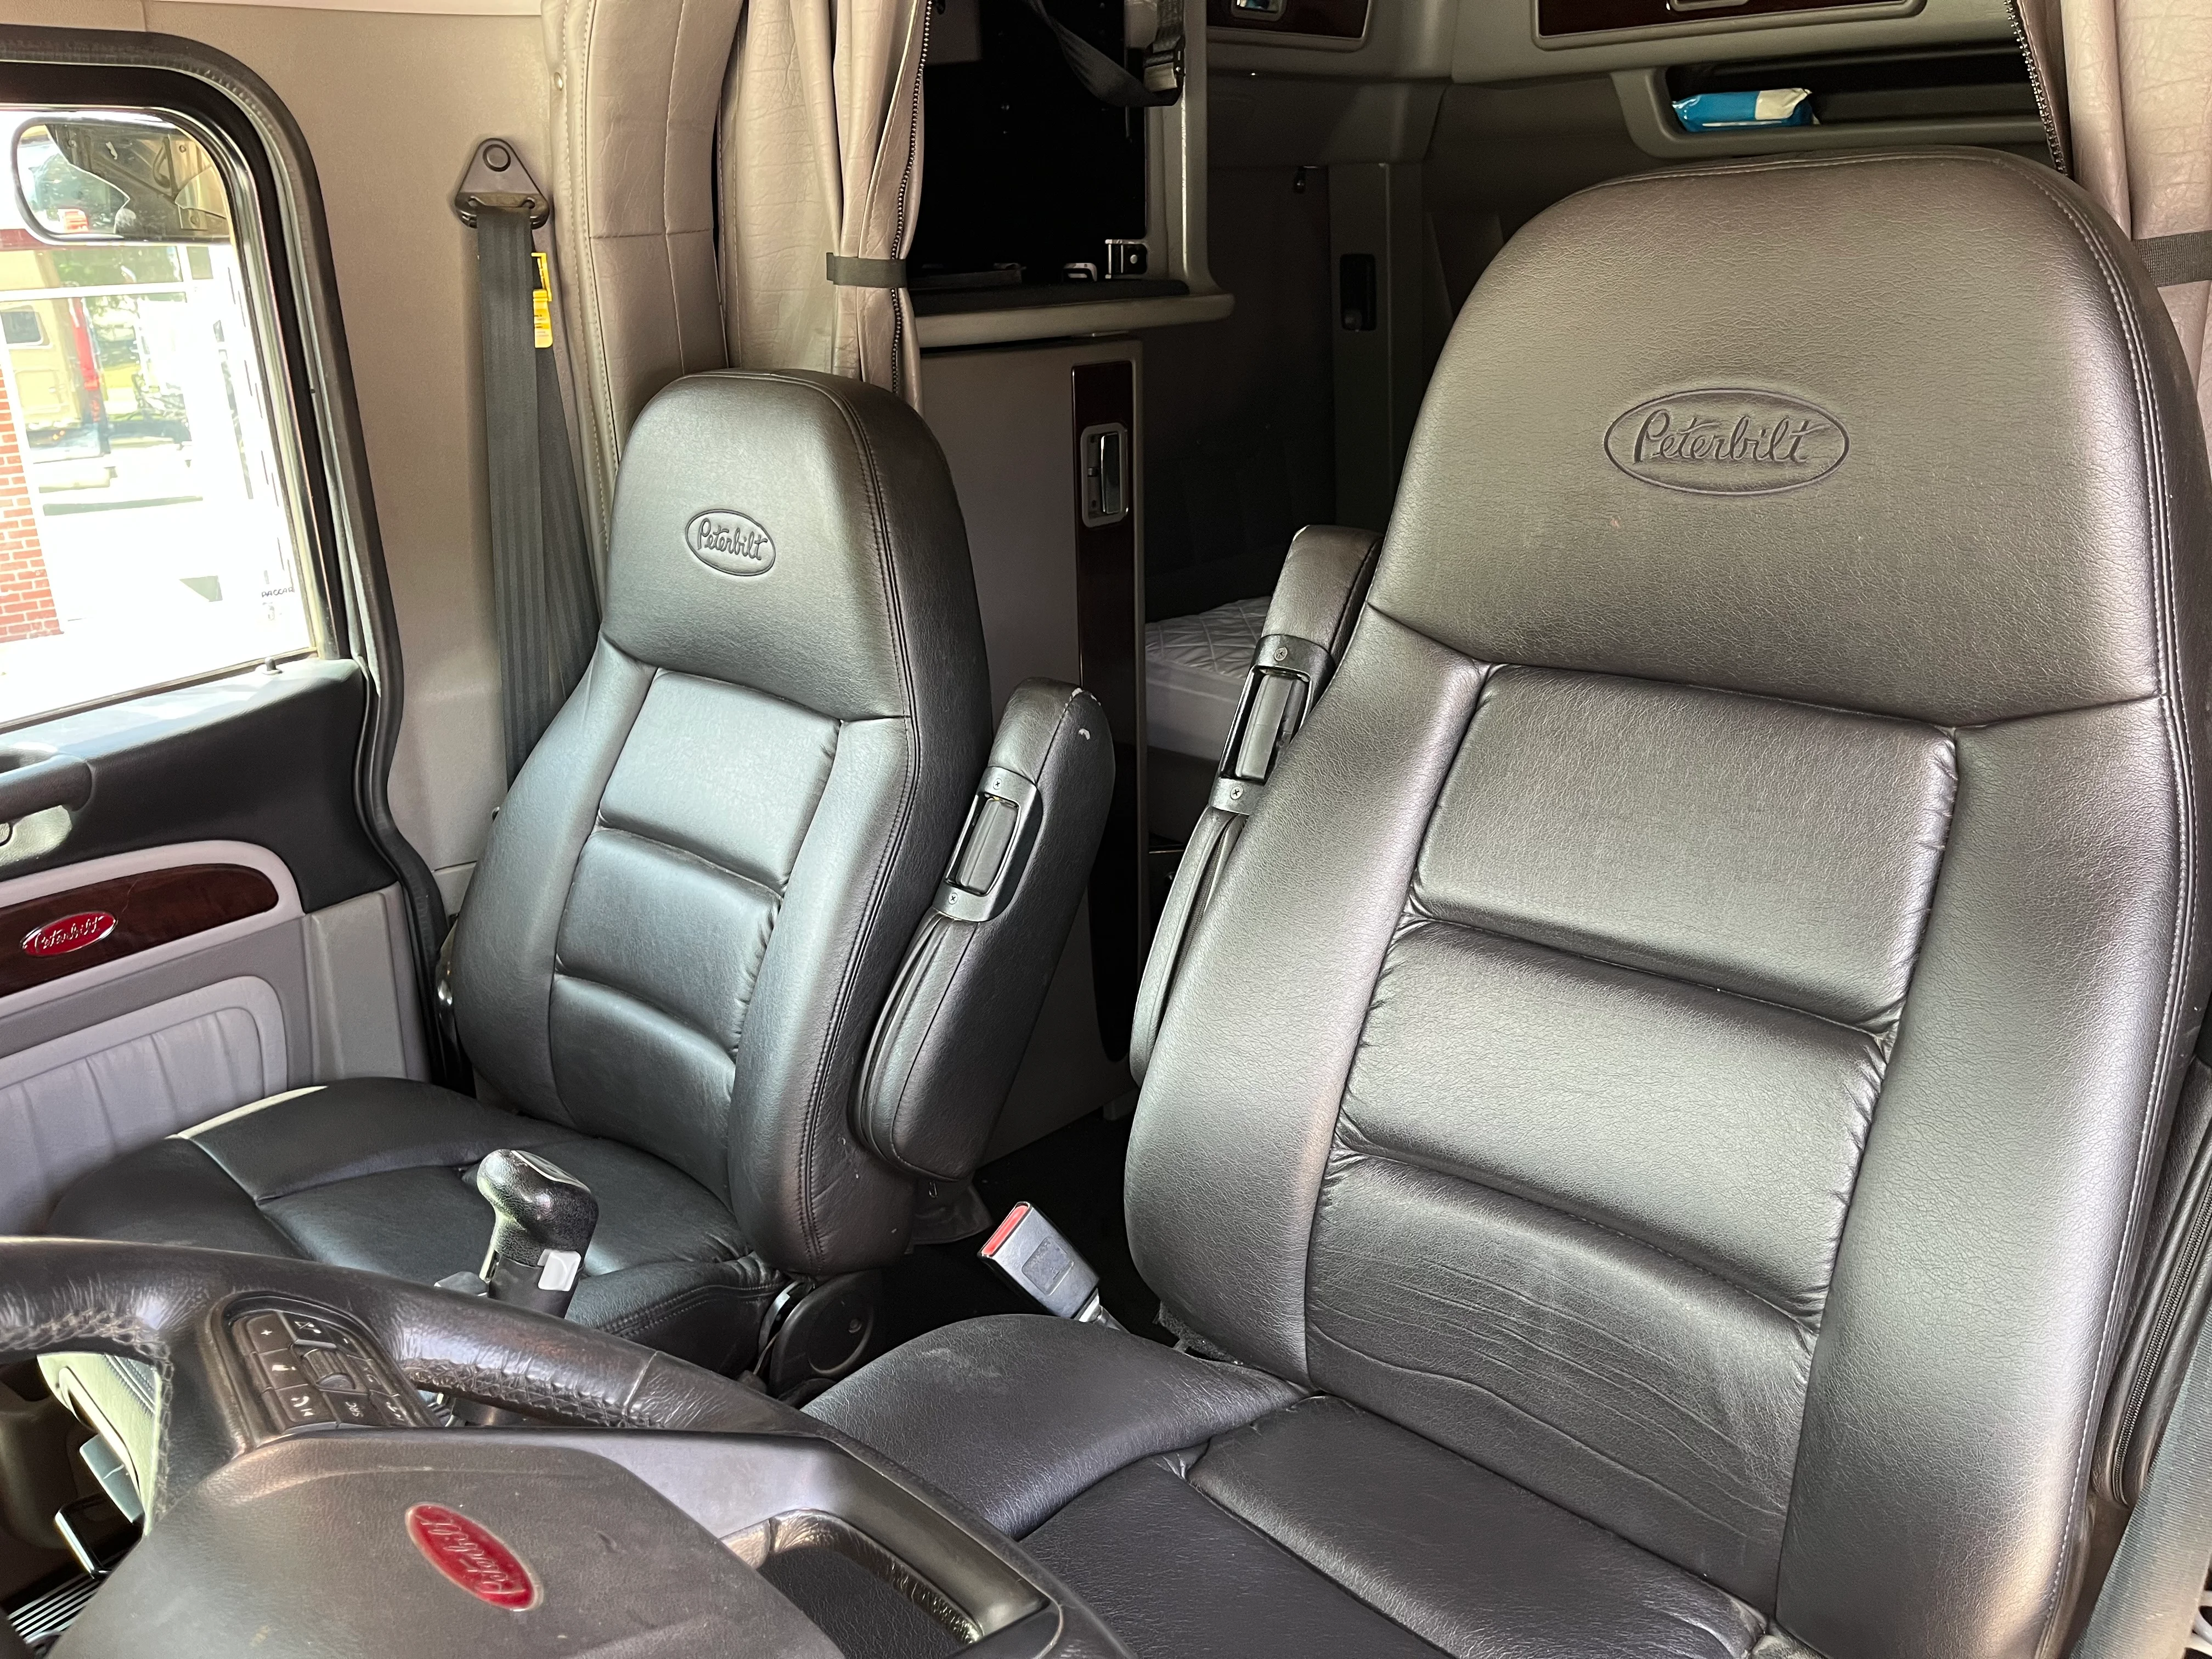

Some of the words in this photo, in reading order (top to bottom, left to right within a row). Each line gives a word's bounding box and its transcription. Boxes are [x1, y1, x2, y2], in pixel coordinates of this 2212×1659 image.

[1633, 409, 1832, 465] Peterbilt
[697, 517, 768, 561] Peterbilt
[34, 915, 105, 953] Peterbilt
[415, 1514, 527, 1594] Peterbilt
